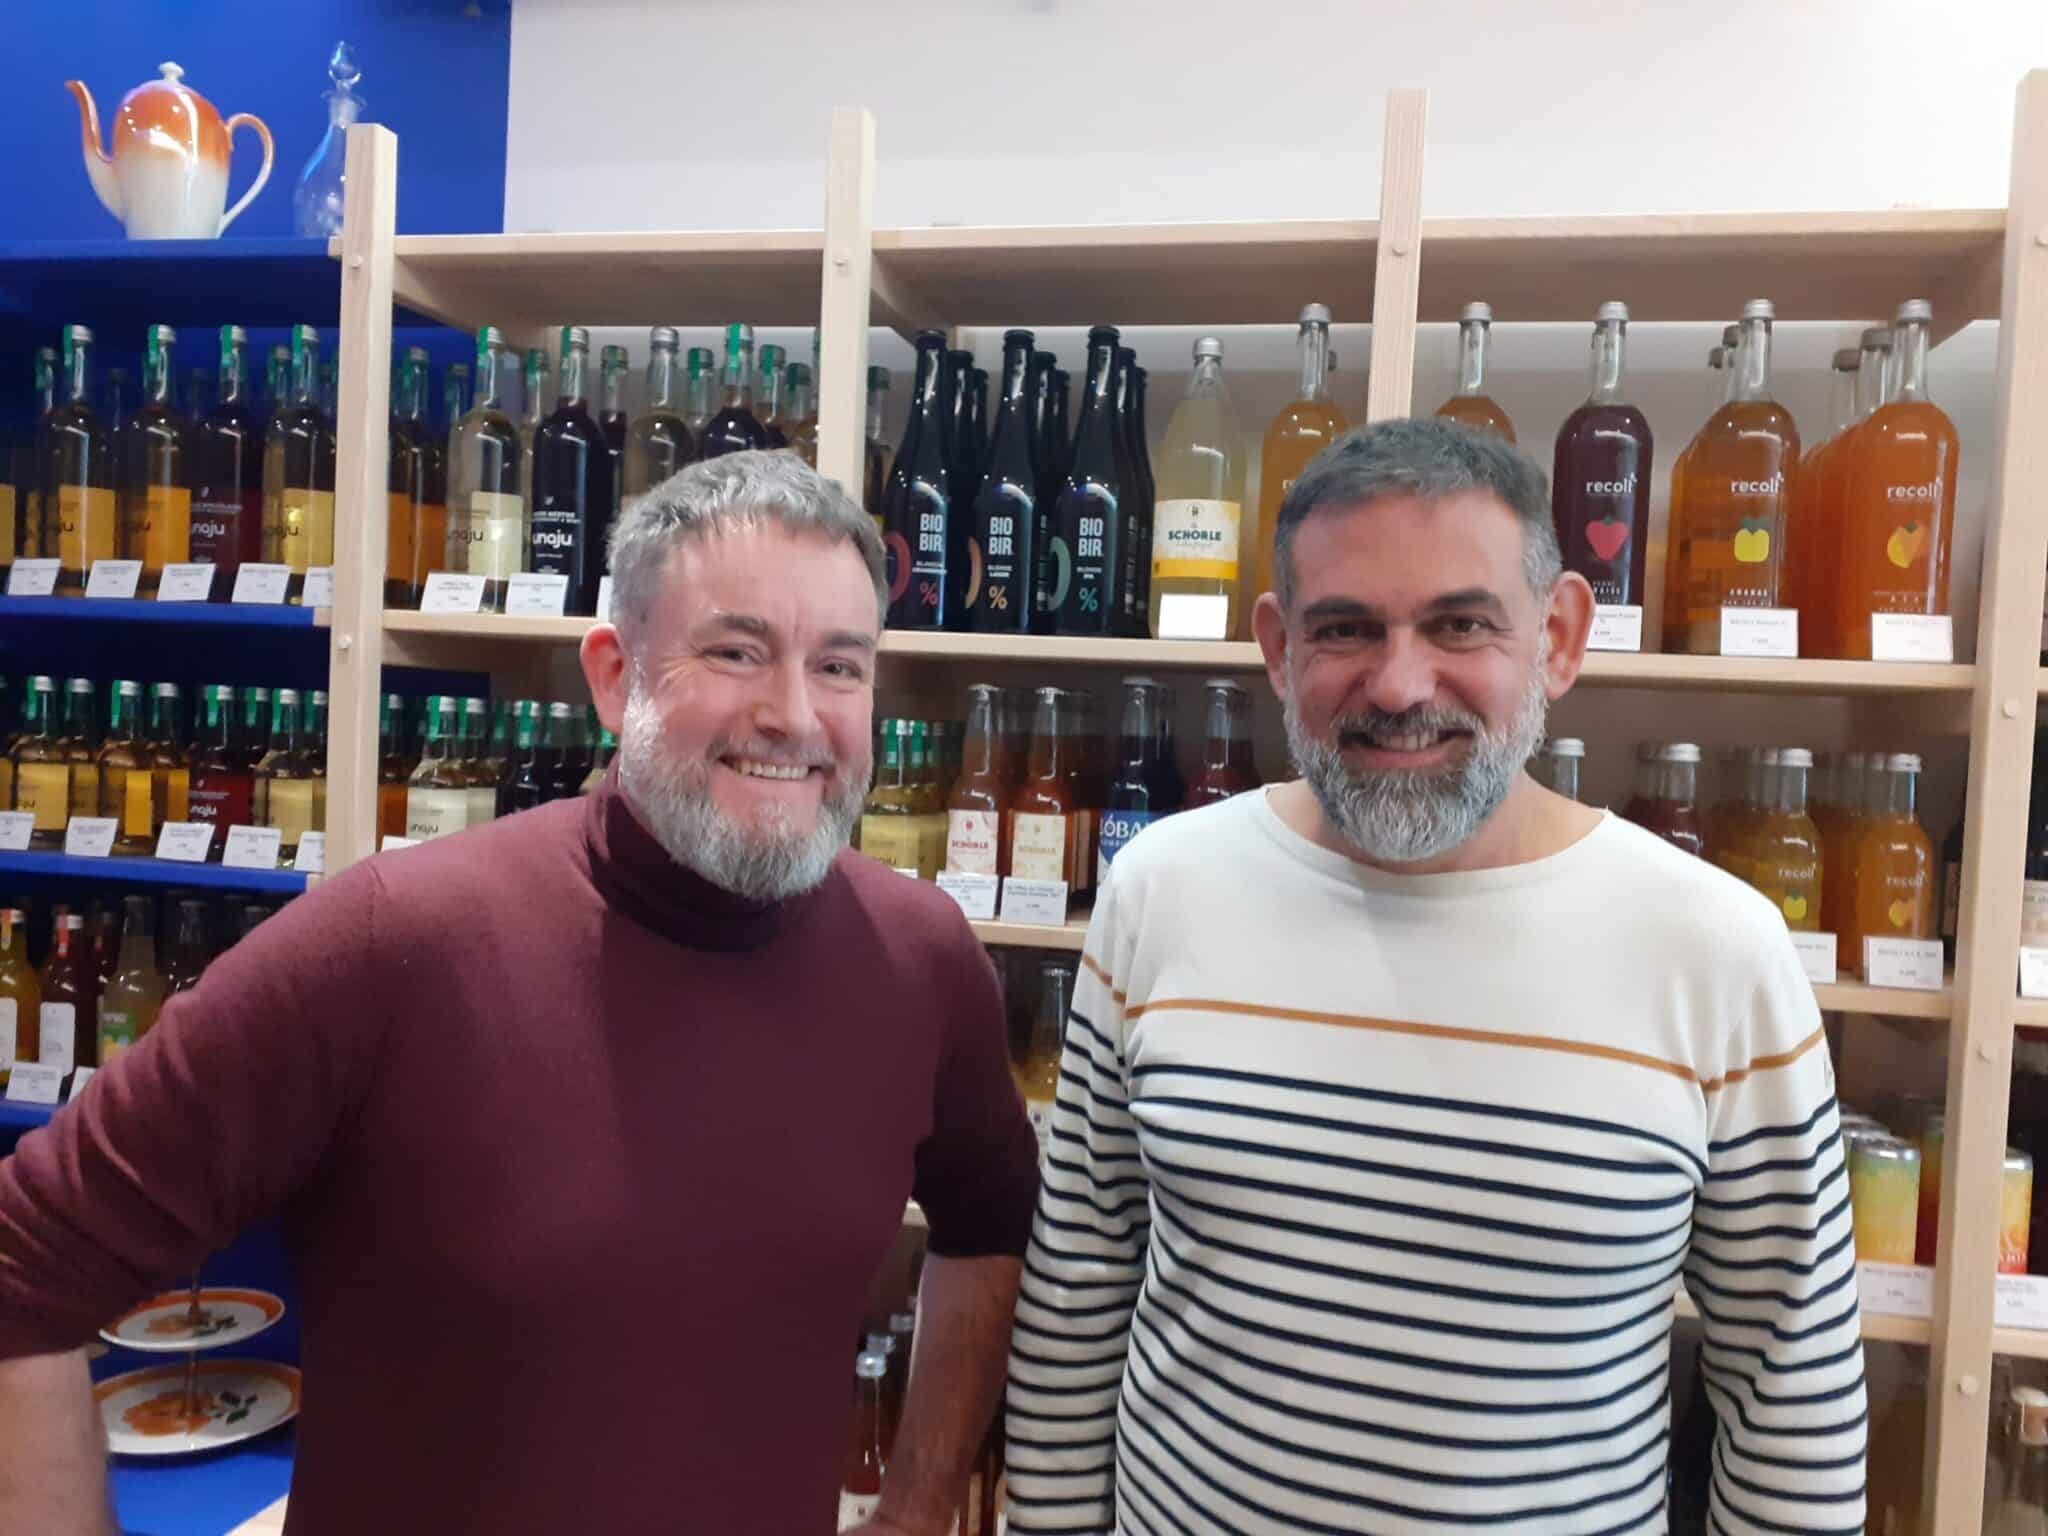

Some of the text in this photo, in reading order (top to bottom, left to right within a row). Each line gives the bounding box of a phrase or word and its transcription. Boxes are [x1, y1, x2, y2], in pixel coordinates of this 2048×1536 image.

[920, 512, 944, 533] BIO
[990, 516, 1013, 535] BIO
[1080, 517, 1104, 537] BIO
[919, 532, 943, 552] BIR
[989, 536, 1013, 555] BIR
[1078, 537, 1104, 557] BIR
